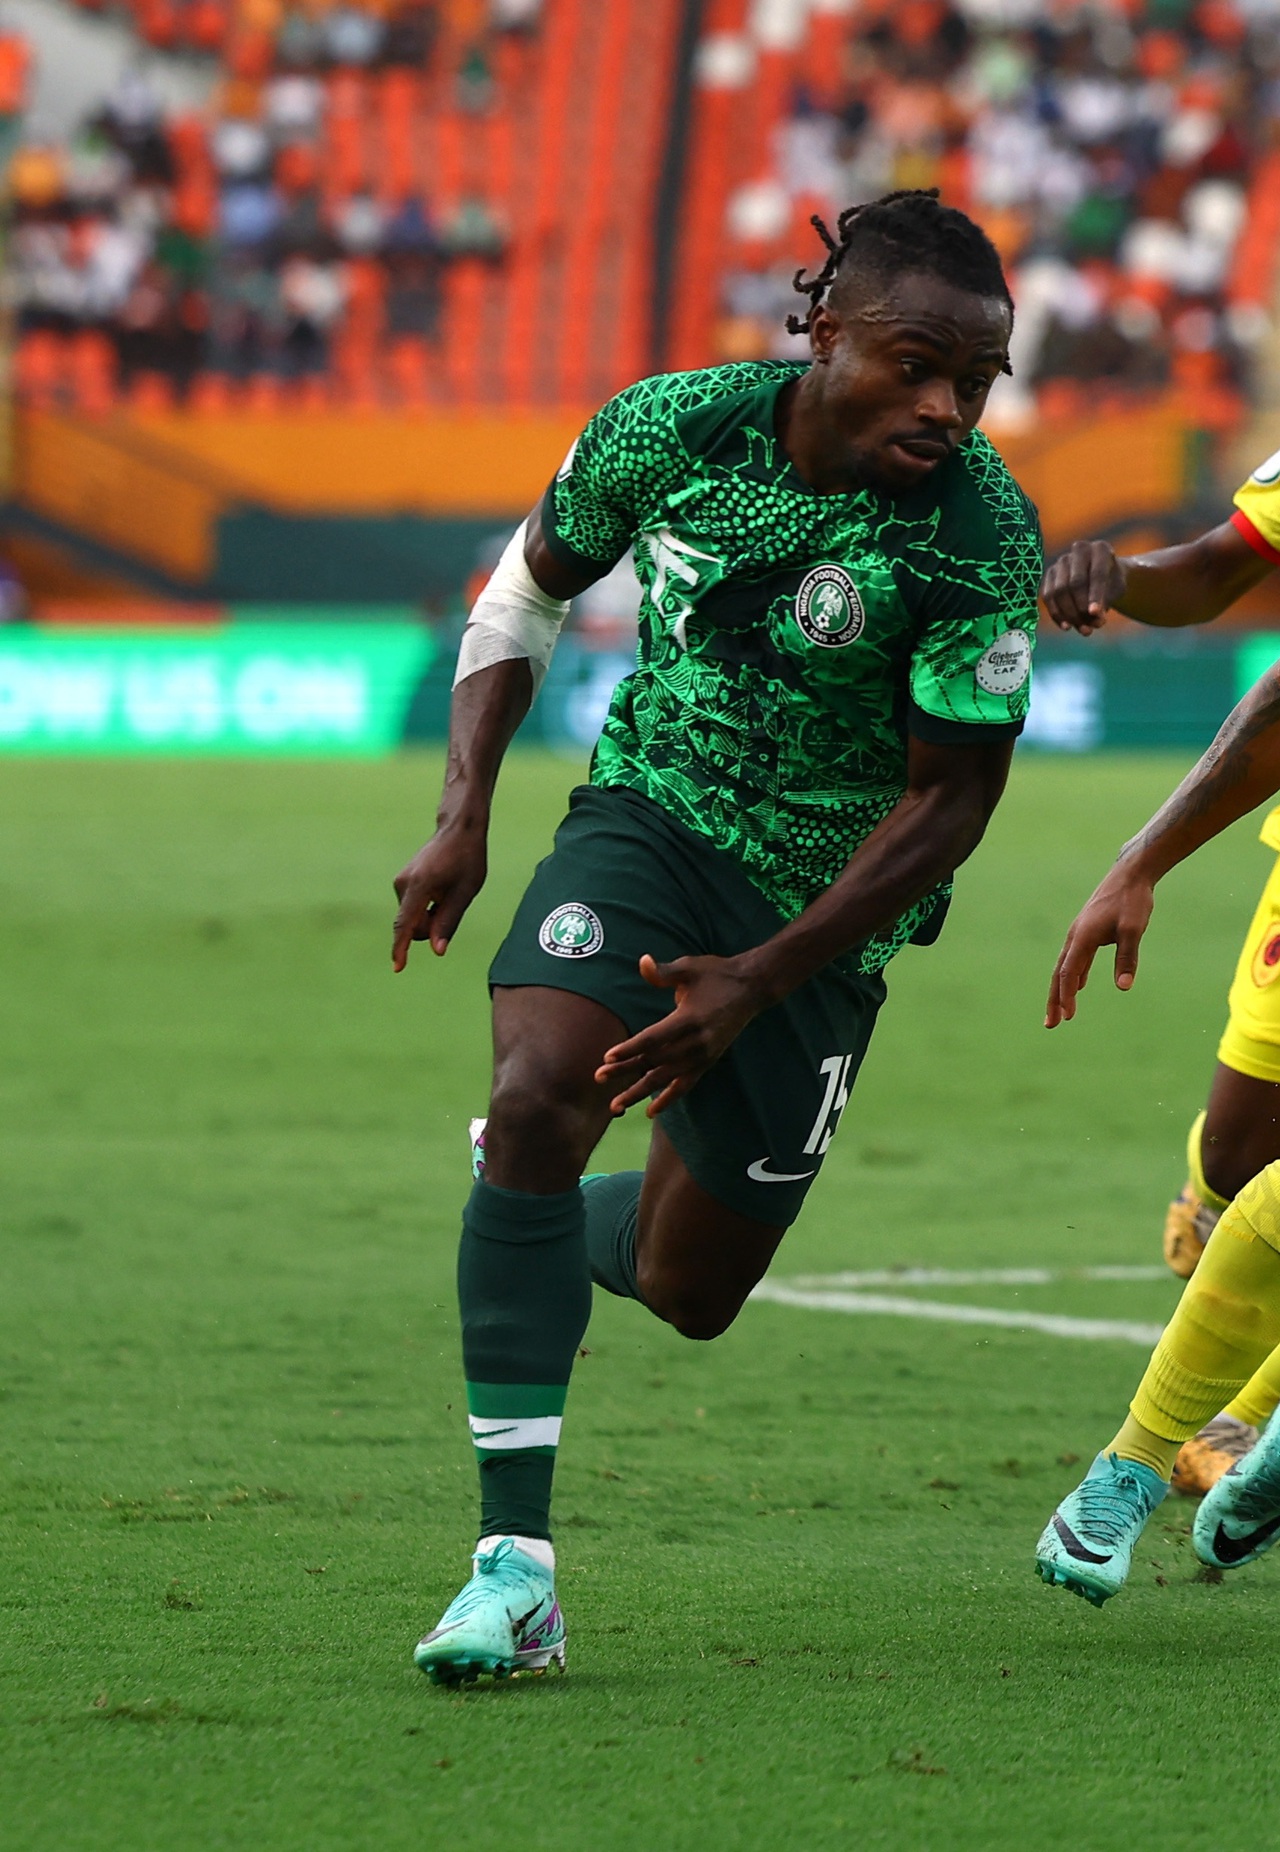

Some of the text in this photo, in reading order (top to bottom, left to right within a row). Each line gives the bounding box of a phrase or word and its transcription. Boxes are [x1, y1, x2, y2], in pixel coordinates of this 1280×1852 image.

[800, 570, 861, 641] NIGERIA FOOTBALL FEDERATION
[809, 628, 828, 642] 1945
[994, 667, 1015, 675] CAF
